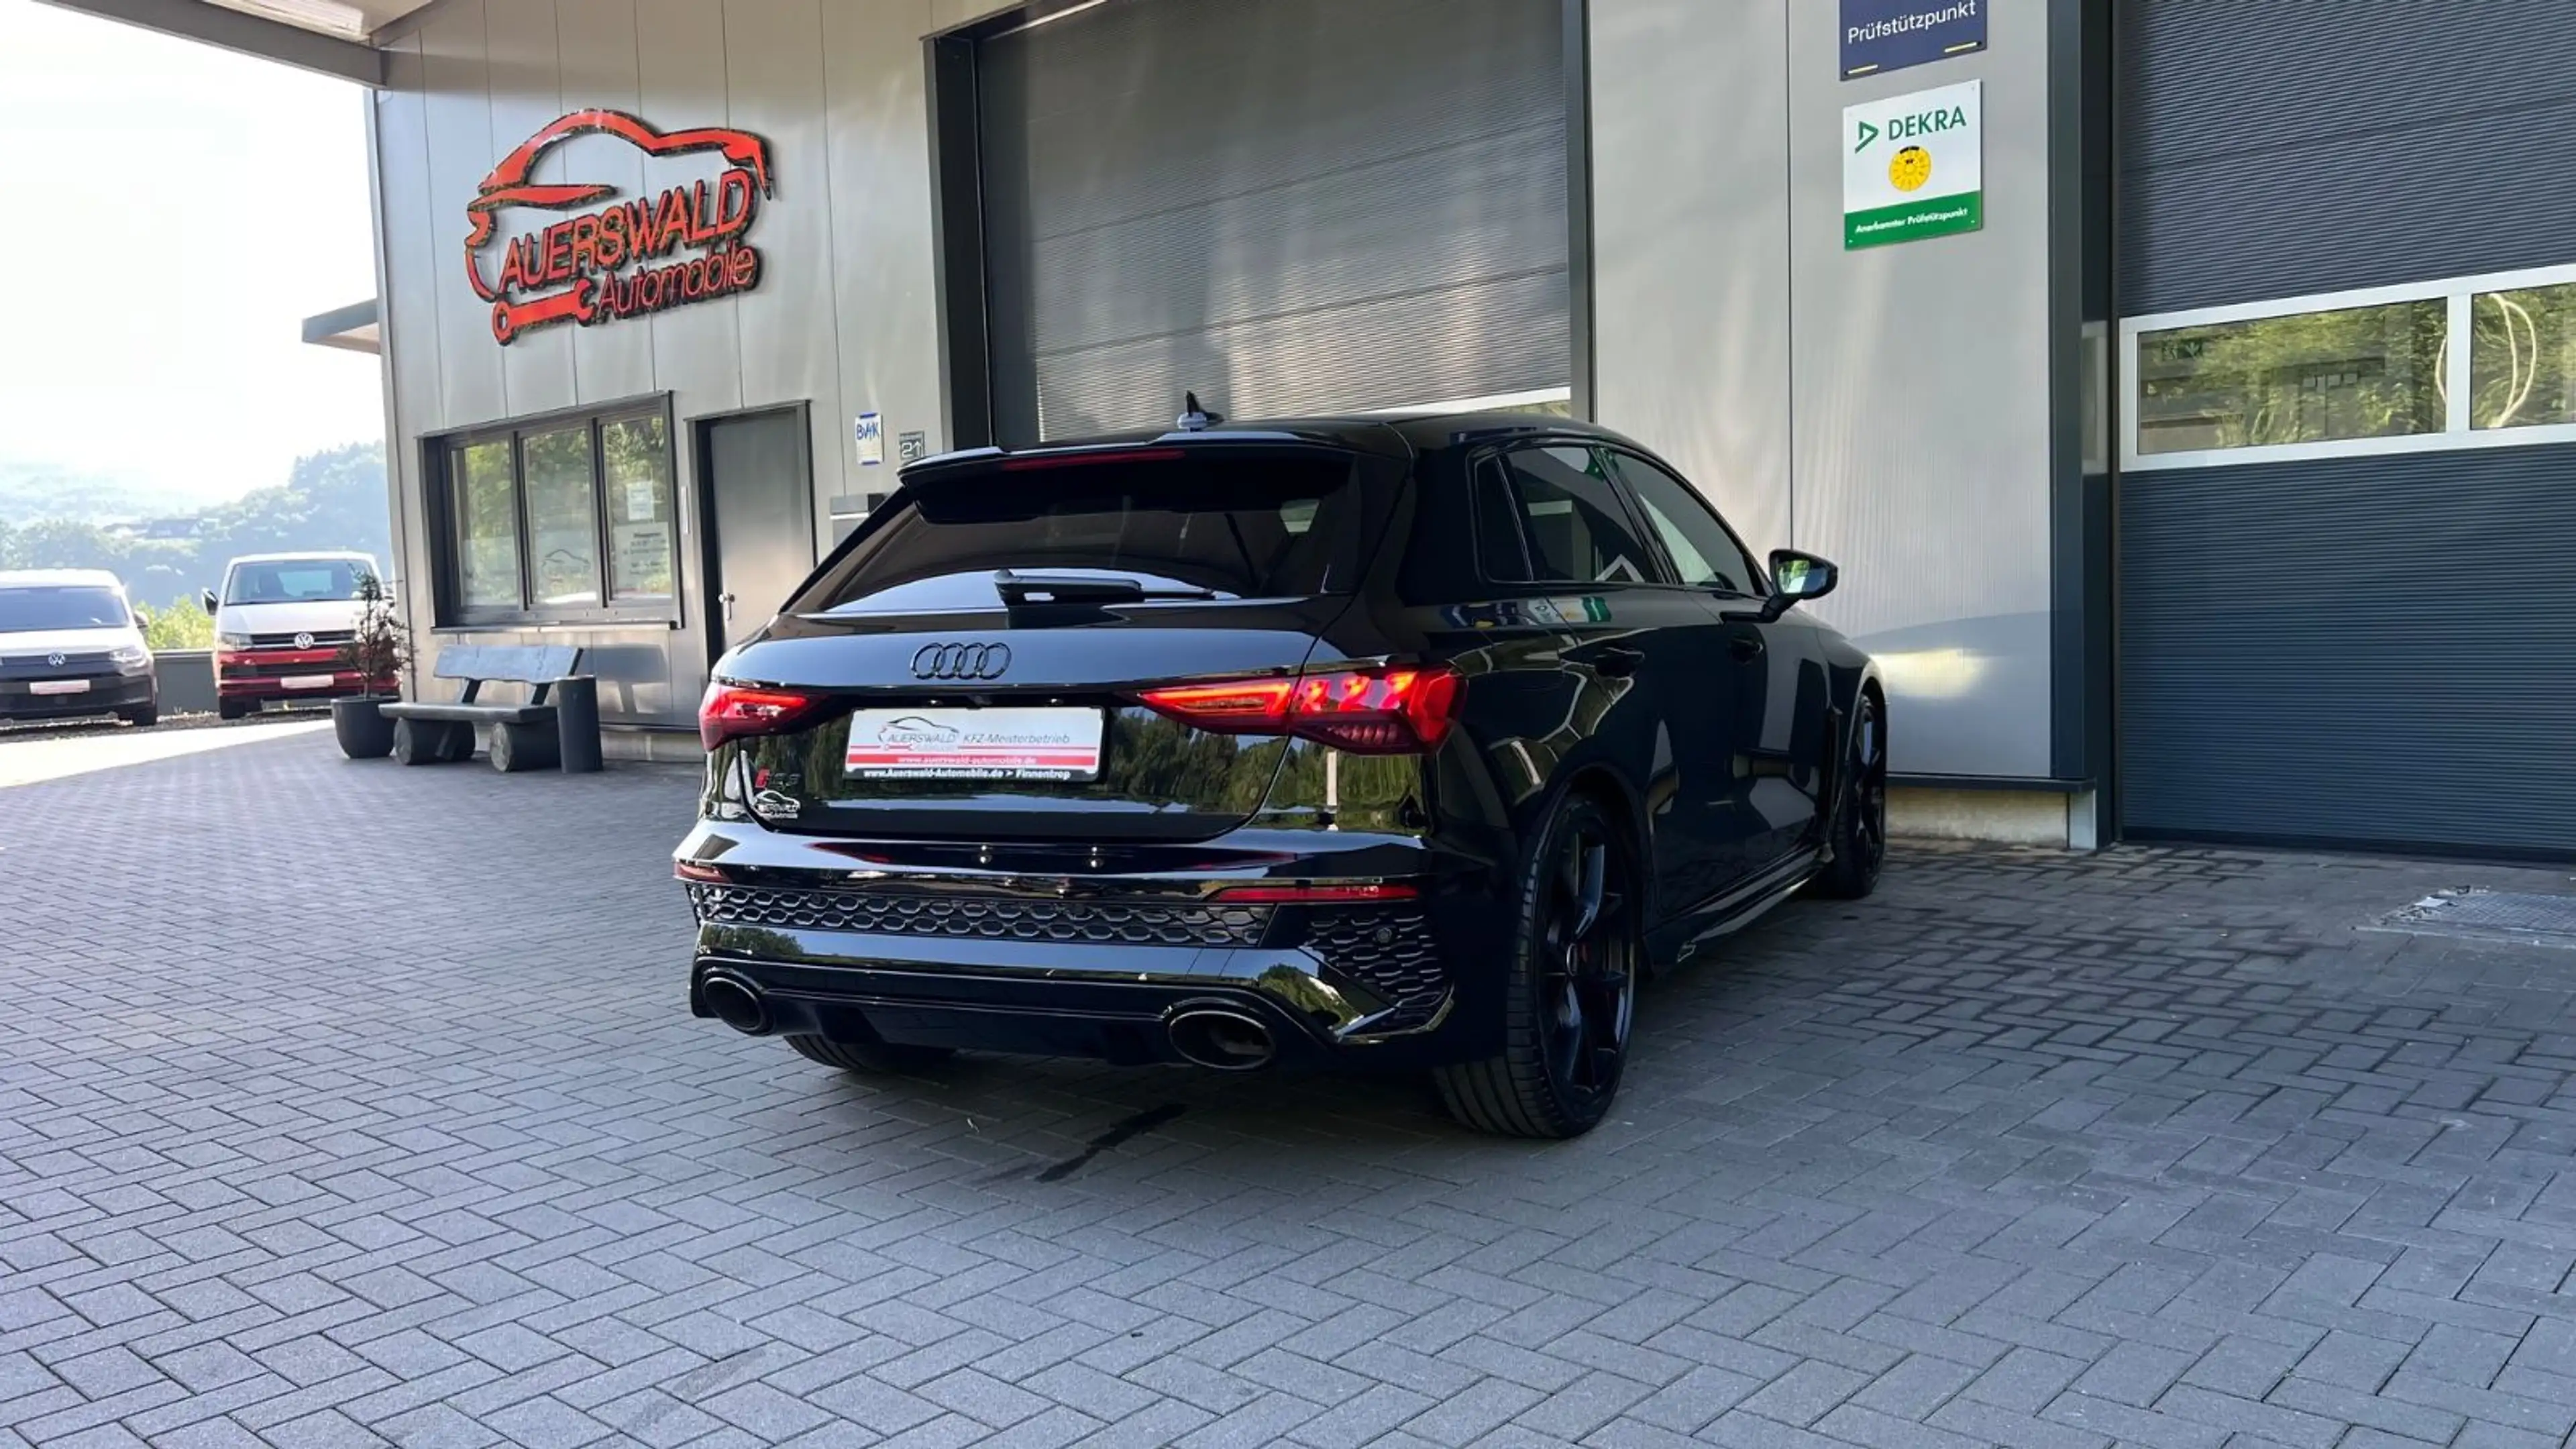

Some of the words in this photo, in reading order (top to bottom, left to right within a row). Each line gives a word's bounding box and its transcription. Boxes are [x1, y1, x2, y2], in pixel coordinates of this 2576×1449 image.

[1847, 0, 1977, 44] Prüfstützpunkt
[1888, 105, 1967, 141] DEKRA
[498, 168, 754, 295] AUERSWALD
[597, 239, 757, 321] Automobile
